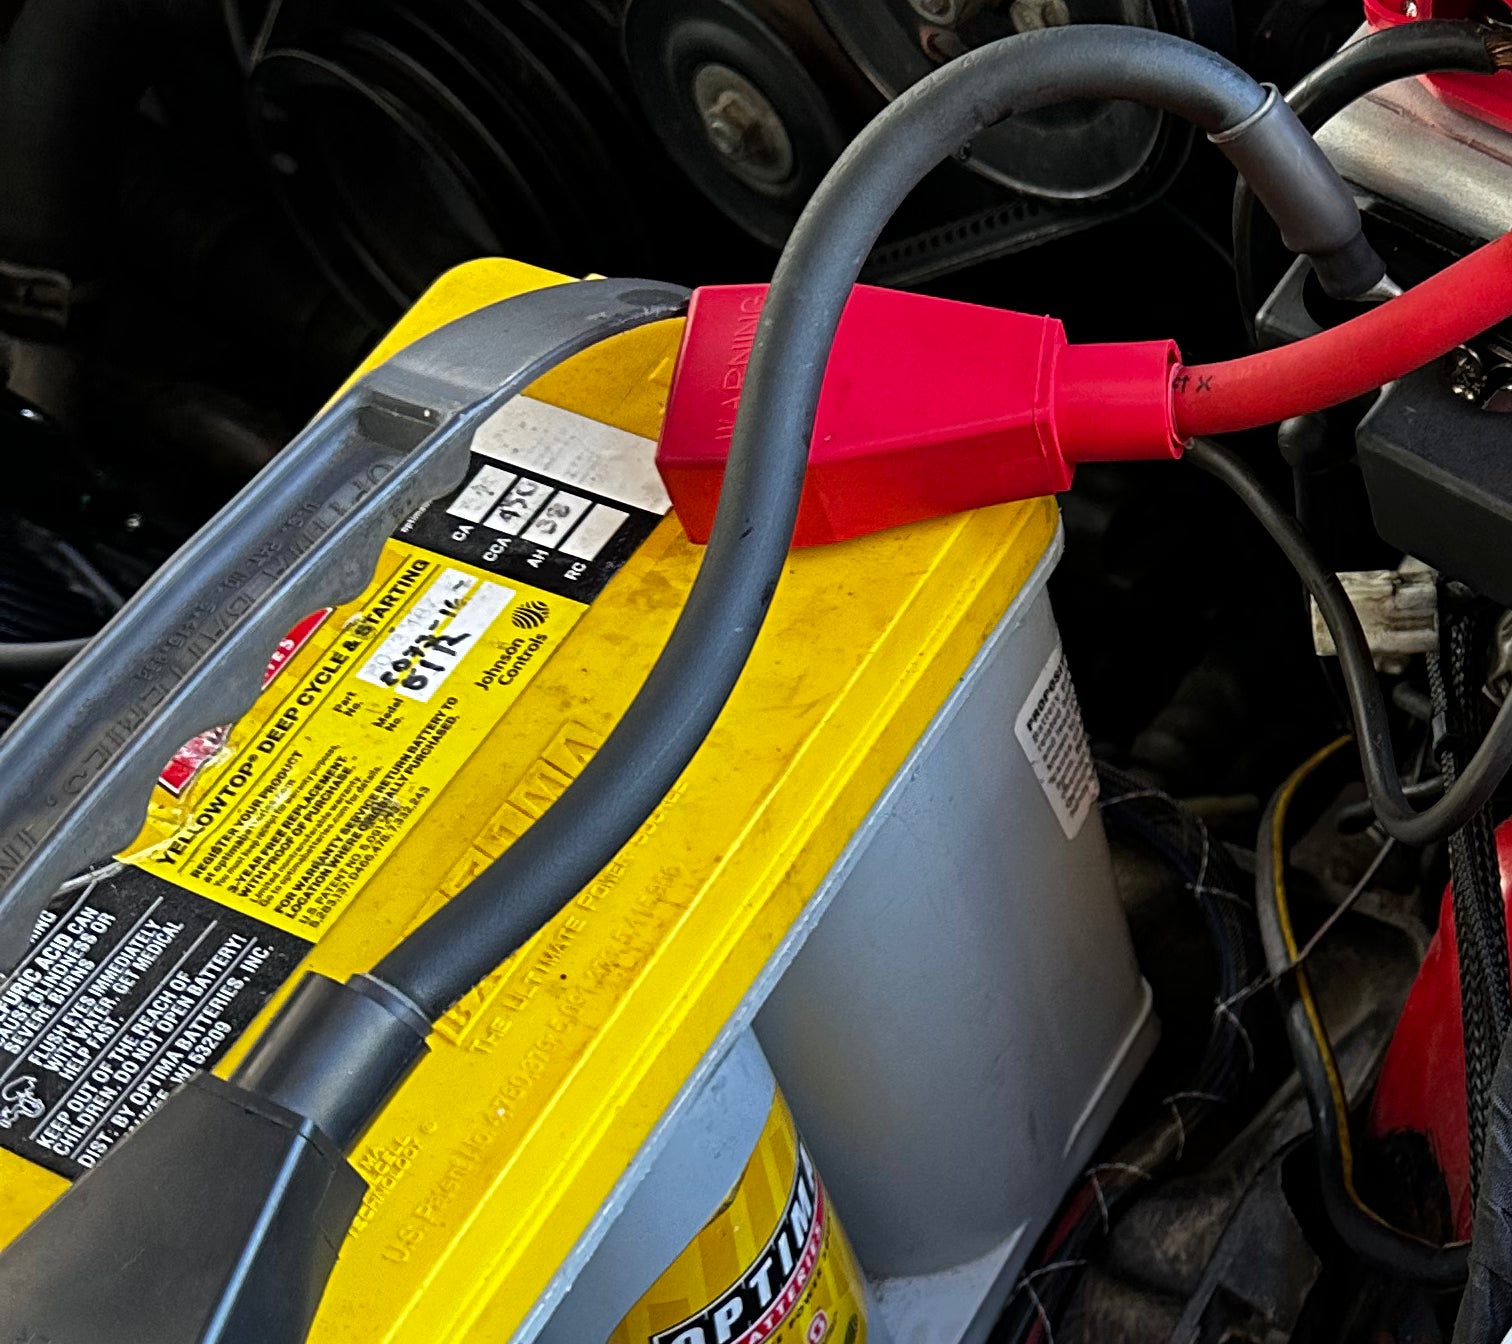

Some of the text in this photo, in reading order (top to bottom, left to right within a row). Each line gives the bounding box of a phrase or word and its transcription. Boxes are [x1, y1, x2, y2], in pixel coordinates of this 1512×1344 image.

[449, 522, 475, 542] CA
[480, 535, 513, 563] CCA
[523, 548, 550, 568] AH
[563, 561, 589, 581] RC
[255, 706, 305, 753] DEEP
[292, 651, 350, 707] CYCLE
[339, 637, 361, 652] &
[352, 557, 431, 637] STARTING
[475, 636, 526, 690] Johnson
[496, 632, 548, 687] Controls
[332, 690, 364, 717] Part No.
[371, 697, 405, 732] Model No.
[189, 750, 305, 878] REGISTER YOUR PRODUCT
[226, 755, 349, 893] 3-YEAR FREE REPLACEMENT
[273, 696, 459, 914] FOR WARRANTY SERVICE RETURN BATTERY TO
[238, 869, 267, 898] WITH
[261, 835, 297, 871] PROOF
[290, 821, 309, 837] OF
[284, 867, 333, 919] LOCATION
[326, 830, 363, 868] WHERE
[314, 867, 350, 904] PATENT
[31, 931, 76, 970] ACID
[65, 905, 100, 935] CAN
[0, 1002, 35, 1045] AUSE
[26, 931, 99, 1005] BLINDNESS
[87, 910, 118, 935] OR
[3, 1002, 57, 1055] SEVERE
[46, 956, 97, 1005] BURNS
[26, 917, 164, 1067] FLUSH EYES IMMEDIATELY
[42, 1037, 82, 1073] WITH
[110, 968, 142, 995] GET
[130, 918, 186, 972] MEDICAL
[111, 1059, 142, 1084] DO
[130, 1030, 166, 1062] NOT
[154, 994, 196, 1034] OPEN
[184, 932, 248, 997] BATTERY!
[34, 969, 195, 1150] KEEP OUT OF THE REACH OF
[57, 1046, 96, 1082] HELP
[109, 1103, 139, 1129] BY
[127, 1048, 185, 1107] OPTIMA
[172, 970, 251, 1053] BATTERIES,
[237, 940, 276, 974] INC.
[169, 1018, 234, 1085] WI 53209
